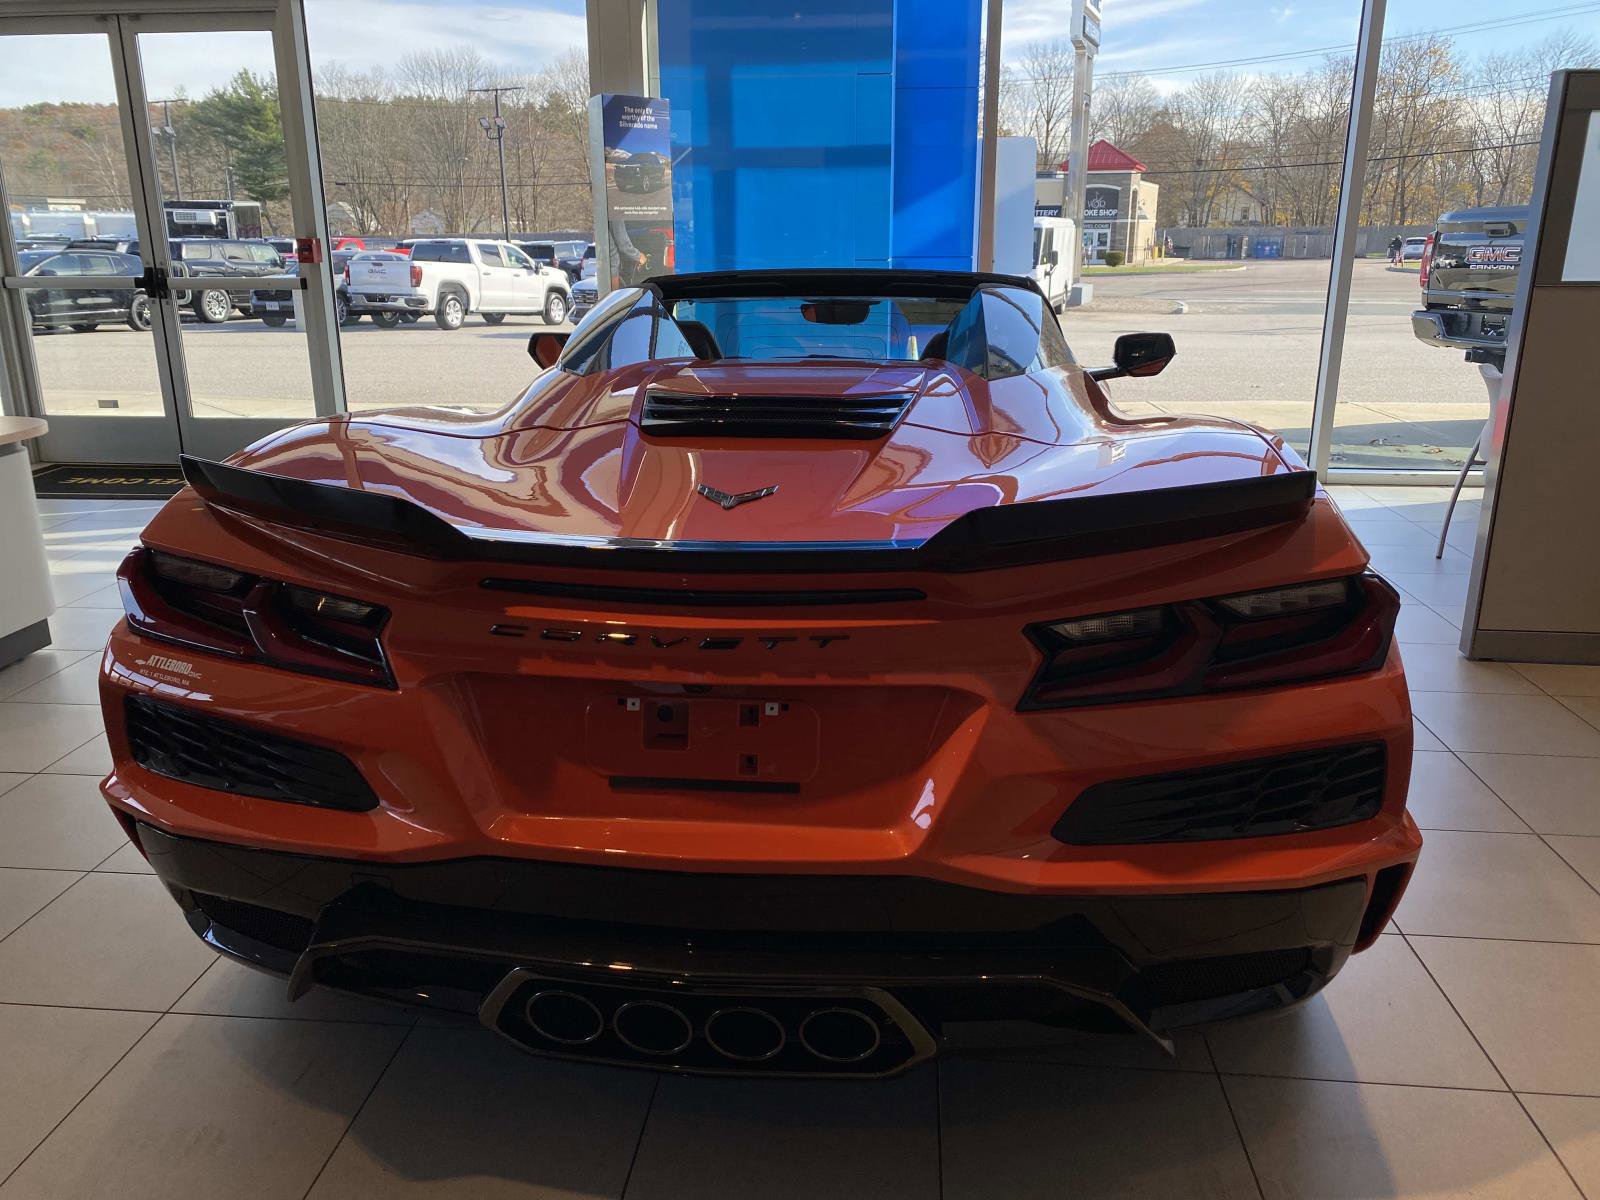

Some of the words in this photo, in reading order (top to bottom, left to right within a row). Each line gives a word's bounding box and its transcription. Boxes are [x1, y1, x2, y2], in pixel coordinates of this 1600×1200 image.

[635, 107, 646, 116] only
[646, 107, 653, 115] EV
[622, 114, 641, 122] worthy
[619, 121, 643, 129] Silverado
[1467, 246, 1522, 262] GMC
[146, 654, 193, 675] ATTLEBORO
